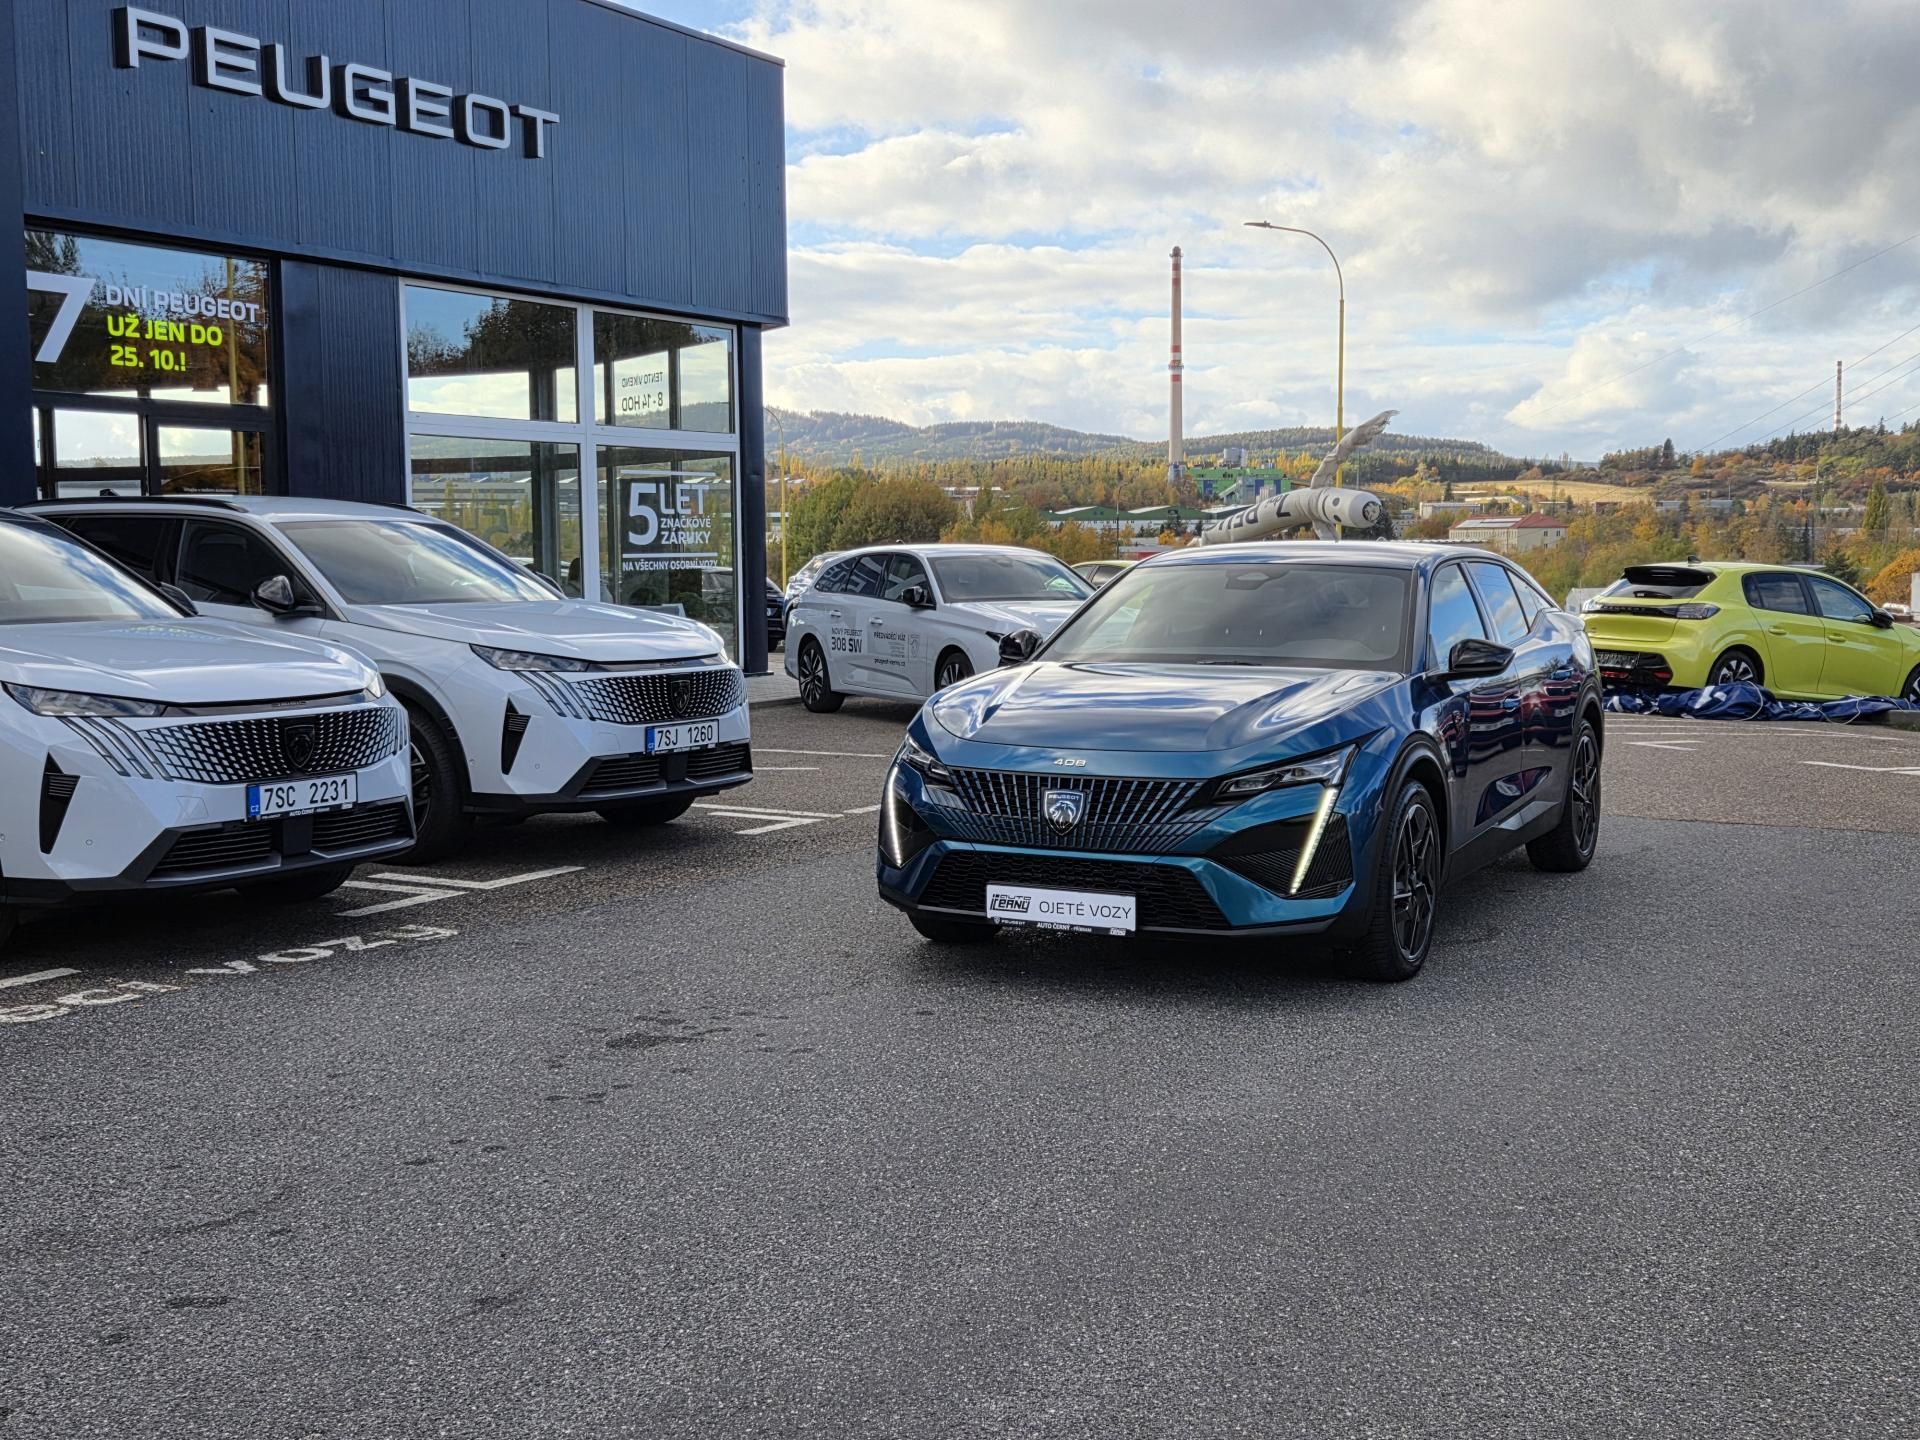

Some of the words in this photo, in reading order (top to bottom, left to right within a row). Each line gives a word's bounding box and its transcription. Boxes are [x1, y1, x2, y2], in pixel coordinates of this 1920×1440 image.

[115, 6, 560, 159] PEUGEOT
[105, 284, 147, 308] DNÍ
[154, 290, 260, 323] PEUGEOT
[27, 269, 96, 363] 7
[107, 312, 141, 338] UŽ
[145, 320, 185, 343] JEN
[191, 324, 223, 346] DO
[110, 345, 144, 368] 25.
[150, 349, 187, 372] 10.!
[629, 482, 658, 546] 5
[659, 483, 710, 515] LET
[660, 515, 711, 529] ZNAČKOVÉ
[660, 528, 711, 545] ZÁRUKY
[622, 561, 634, 572] NA
[635, 558, 669, 571] VŠECHNY
[831, 636, 846, 651] 308
[848, 638, 862, 653] SW
[657, 728, 678, 748] 7SJ
[688, 725, 713, 744] 1260
[1053, 758, 1087, 767] 408
[264, 785, 295, 811] 7SC
[309, 779, 348, 804] 2231
[1039, 901, 1085, 916] OJETÉ
[1089, 904, 1132, 920] VOZY
[1036, 921, 1052, 929] AUTO
